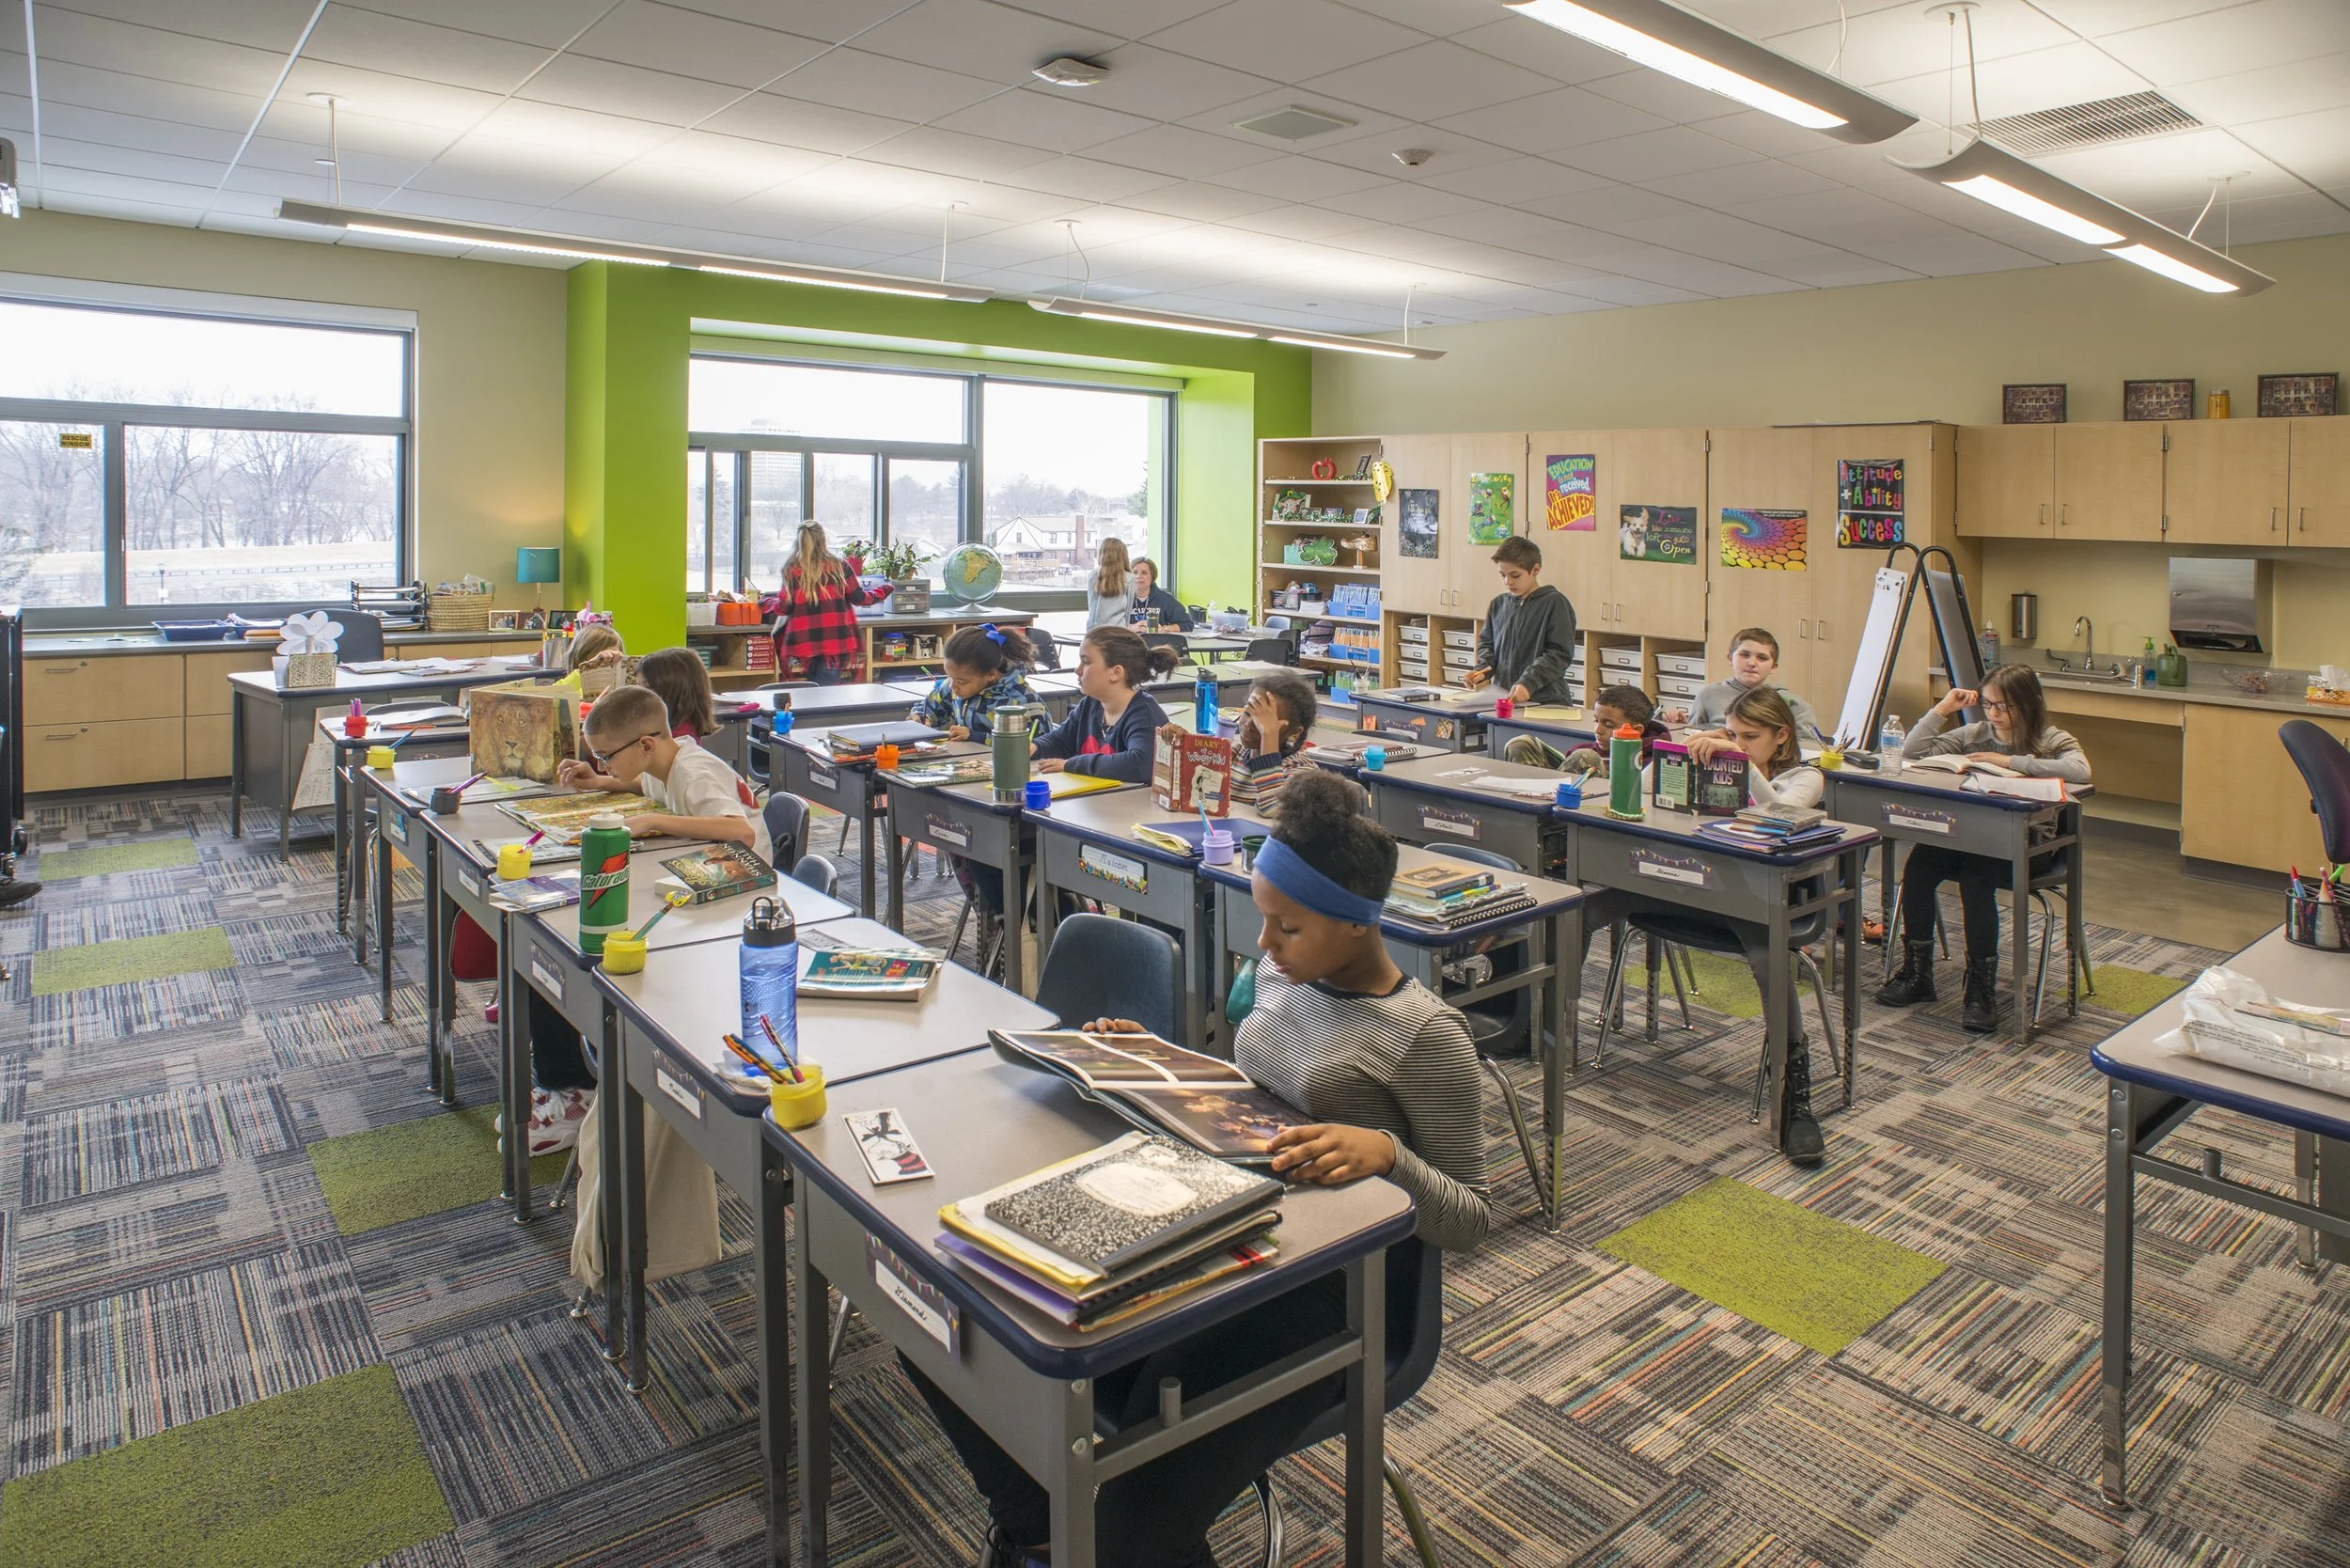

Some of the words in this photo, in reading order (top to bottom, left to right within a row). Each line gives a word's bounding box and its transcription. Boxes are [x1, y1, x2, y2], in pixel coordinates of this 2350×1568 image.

[1547, 458, 1594, 479] EDUCATION
[1840, 463, 1903, 482] Attitude
[1853, 486, 1903, 510] Ability
[1546, 494, 1595, 530] ACHIEVED!
[1840, 514, 1903, 546] Success
[1660, 539, 1693, 558] Open
[1194, 739, 1219, 748] DIARY
[1187, 752, 1213, 765] Wimpy
[1212, 752, 1227, 765] Kid
[1713, 772, 1733, 785] KIDS
[720, 842, 762, 877] SHANNON
[737, 847, 760, 867] HALE
